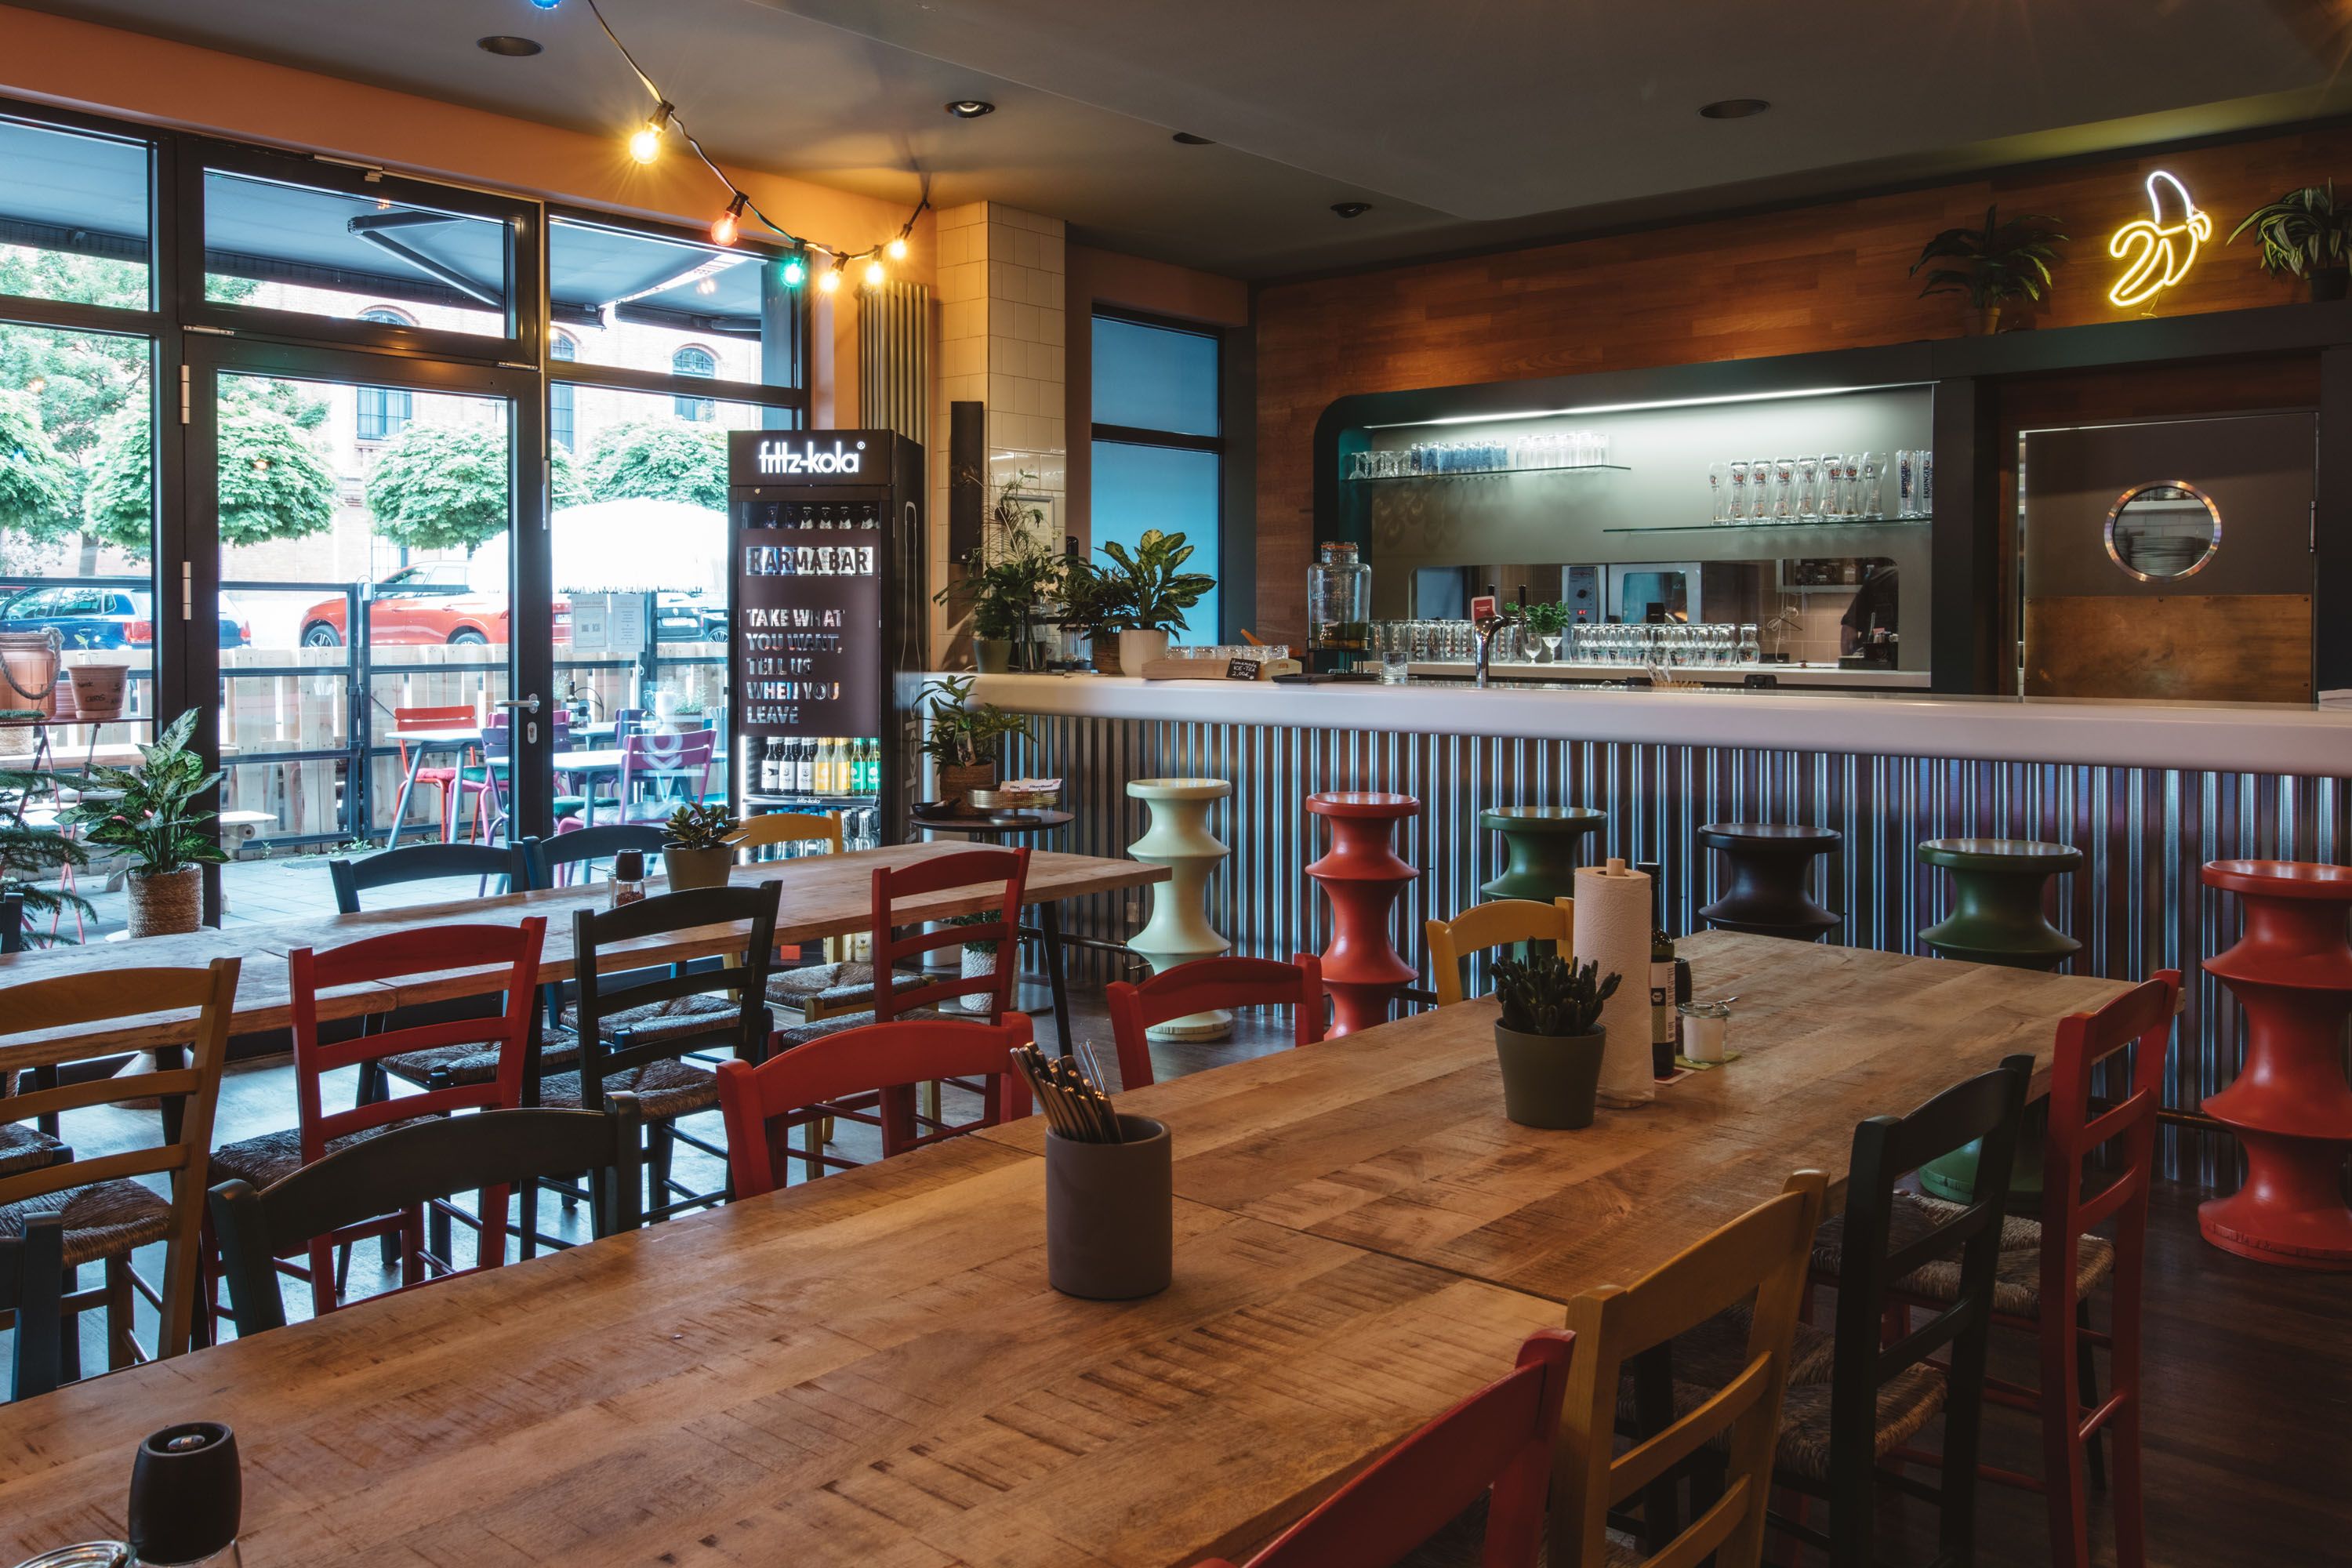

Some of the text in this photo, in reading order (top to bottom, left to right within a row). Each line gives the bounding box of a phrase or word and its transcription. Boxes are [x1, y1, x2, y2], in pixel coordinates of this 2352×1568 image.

[759, 441, 859, 474] fritz-kola
[750, 551, 868, 571] KARMA BAR
[746, 609, 844, 627] TAKE WHAT
[746, 633, 843, 654] YOU WANT,
[746, 658, 813, 676] TELL US
[746, 682, 840, 700] WHEN YOU
[746, 706, 800, 724] LEAVE
